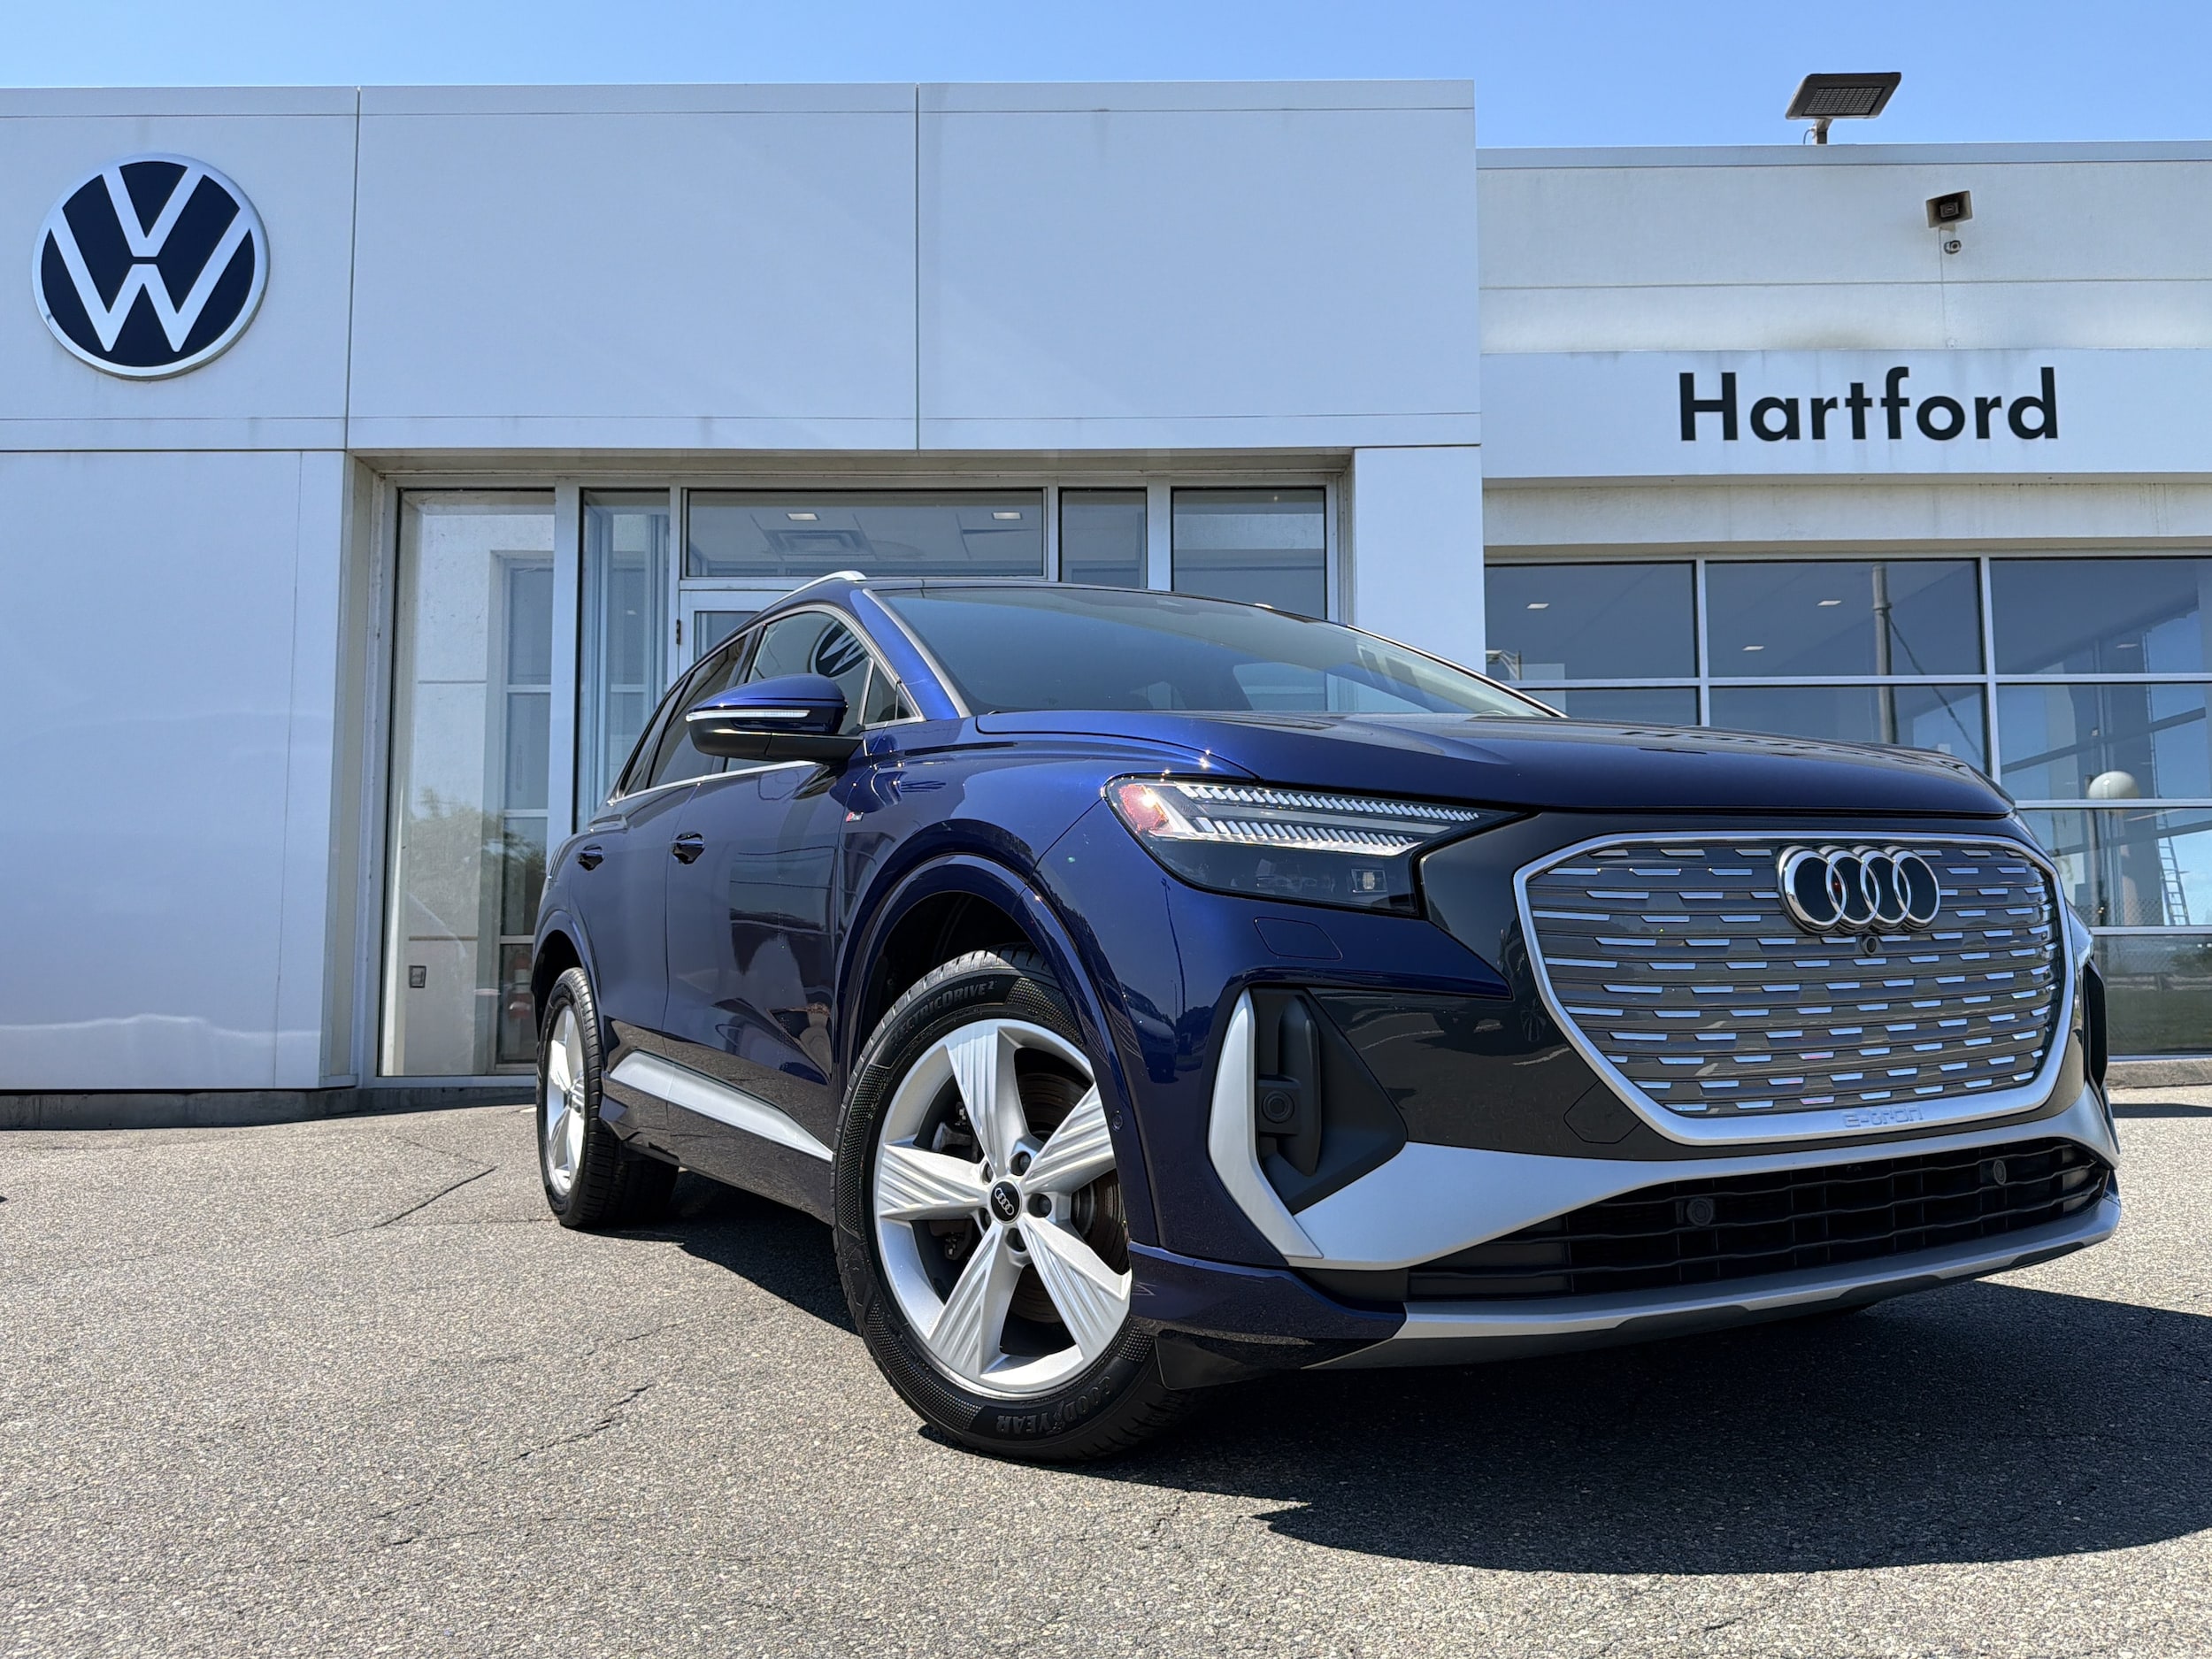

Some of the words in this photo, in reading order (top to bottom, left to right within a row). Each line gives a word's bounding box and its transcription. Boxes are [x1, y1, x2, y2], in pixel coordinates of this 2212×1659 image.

[1678, 365, 2059, 442] Hartford
[1840, 1105, 1924, 1128] e-tron
[995, 1375, 1112, 1435] GOODYEAR
